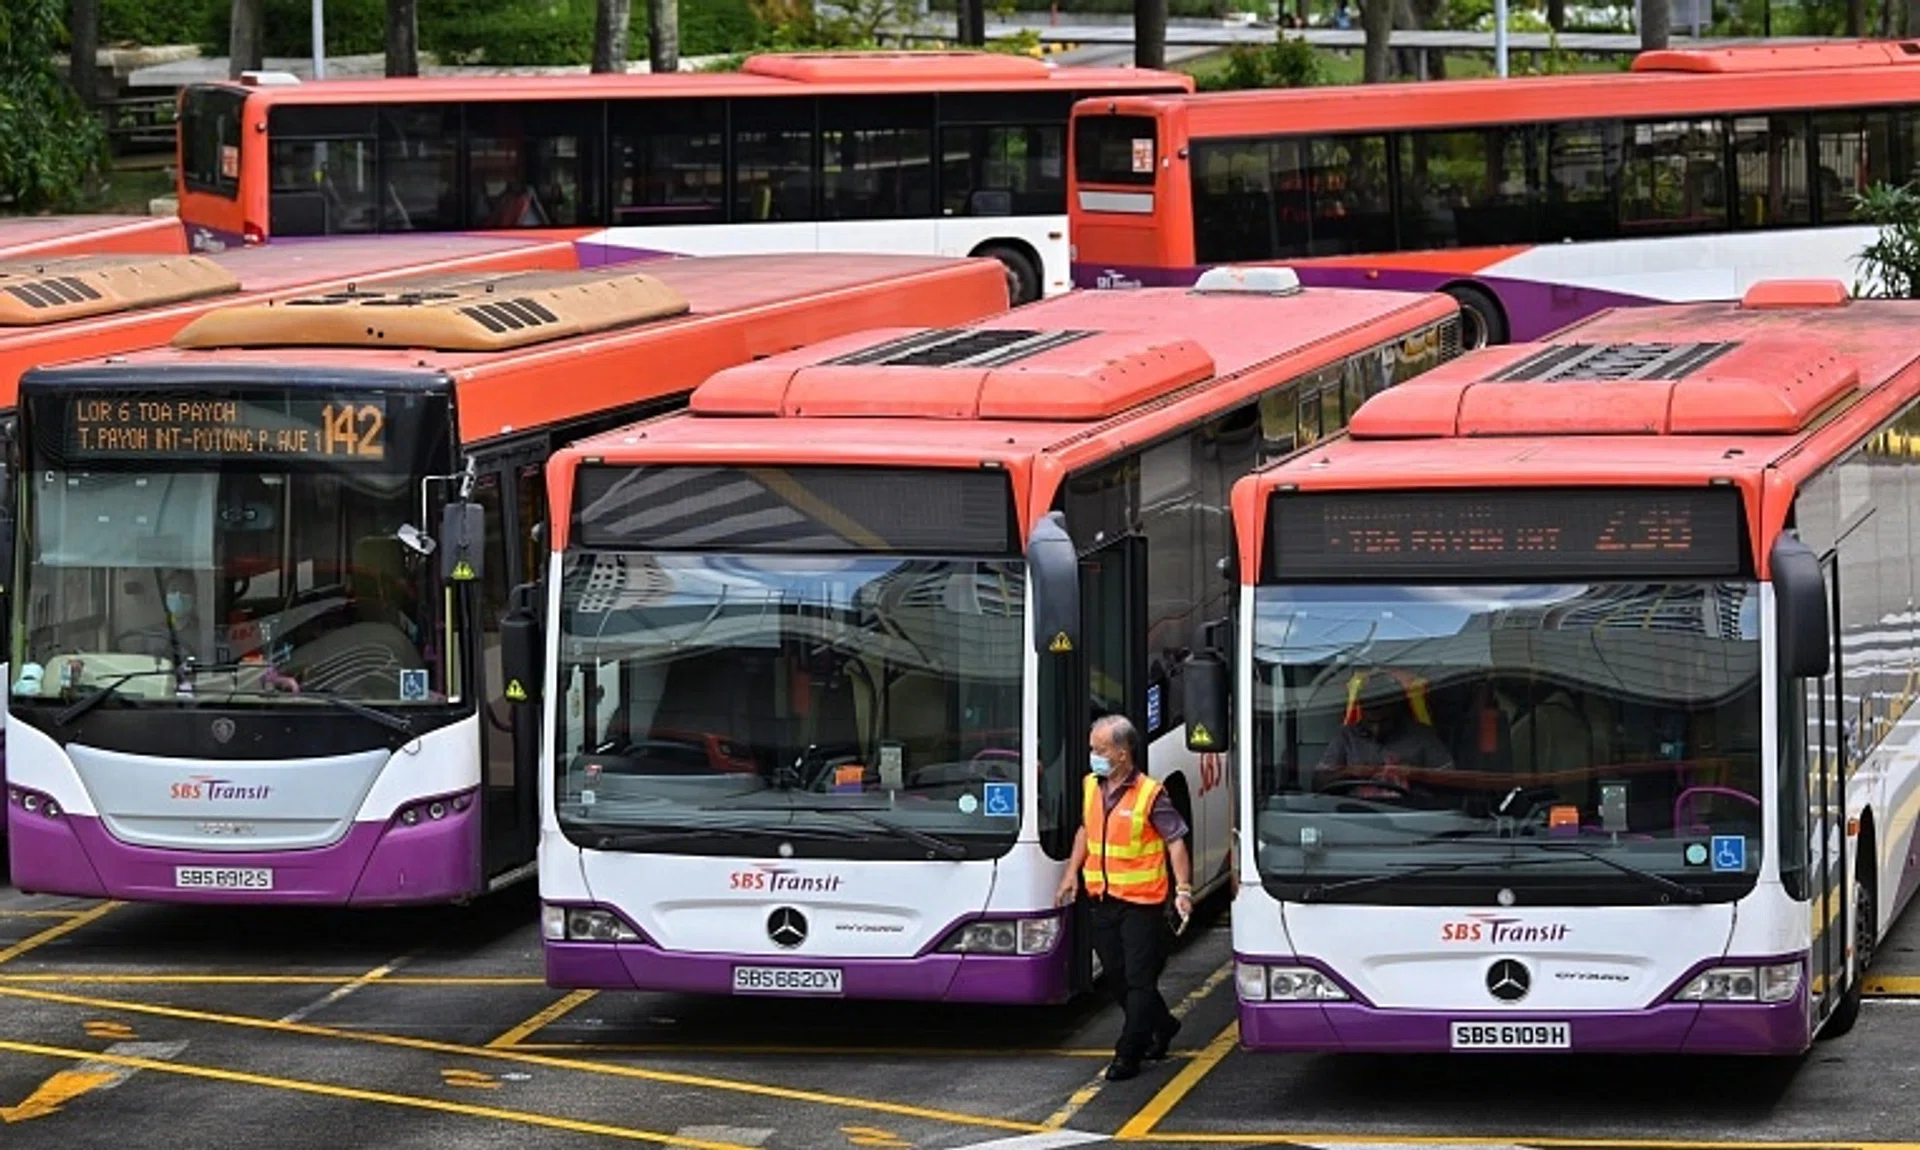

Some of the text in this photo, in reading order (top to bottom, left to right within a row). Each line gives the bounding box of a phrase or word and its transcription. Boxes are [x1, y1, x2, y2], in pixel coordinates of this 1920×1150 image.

[78, 401, 236, 421] LOR 6 TOA PAYOH
[322, 403, 383, 455] 142
[170, 780, 273, 801] SBS Transit
[730, 868, 844, 892] SBS Transit
[1442, 918, 1571, 944] SBS Transit
